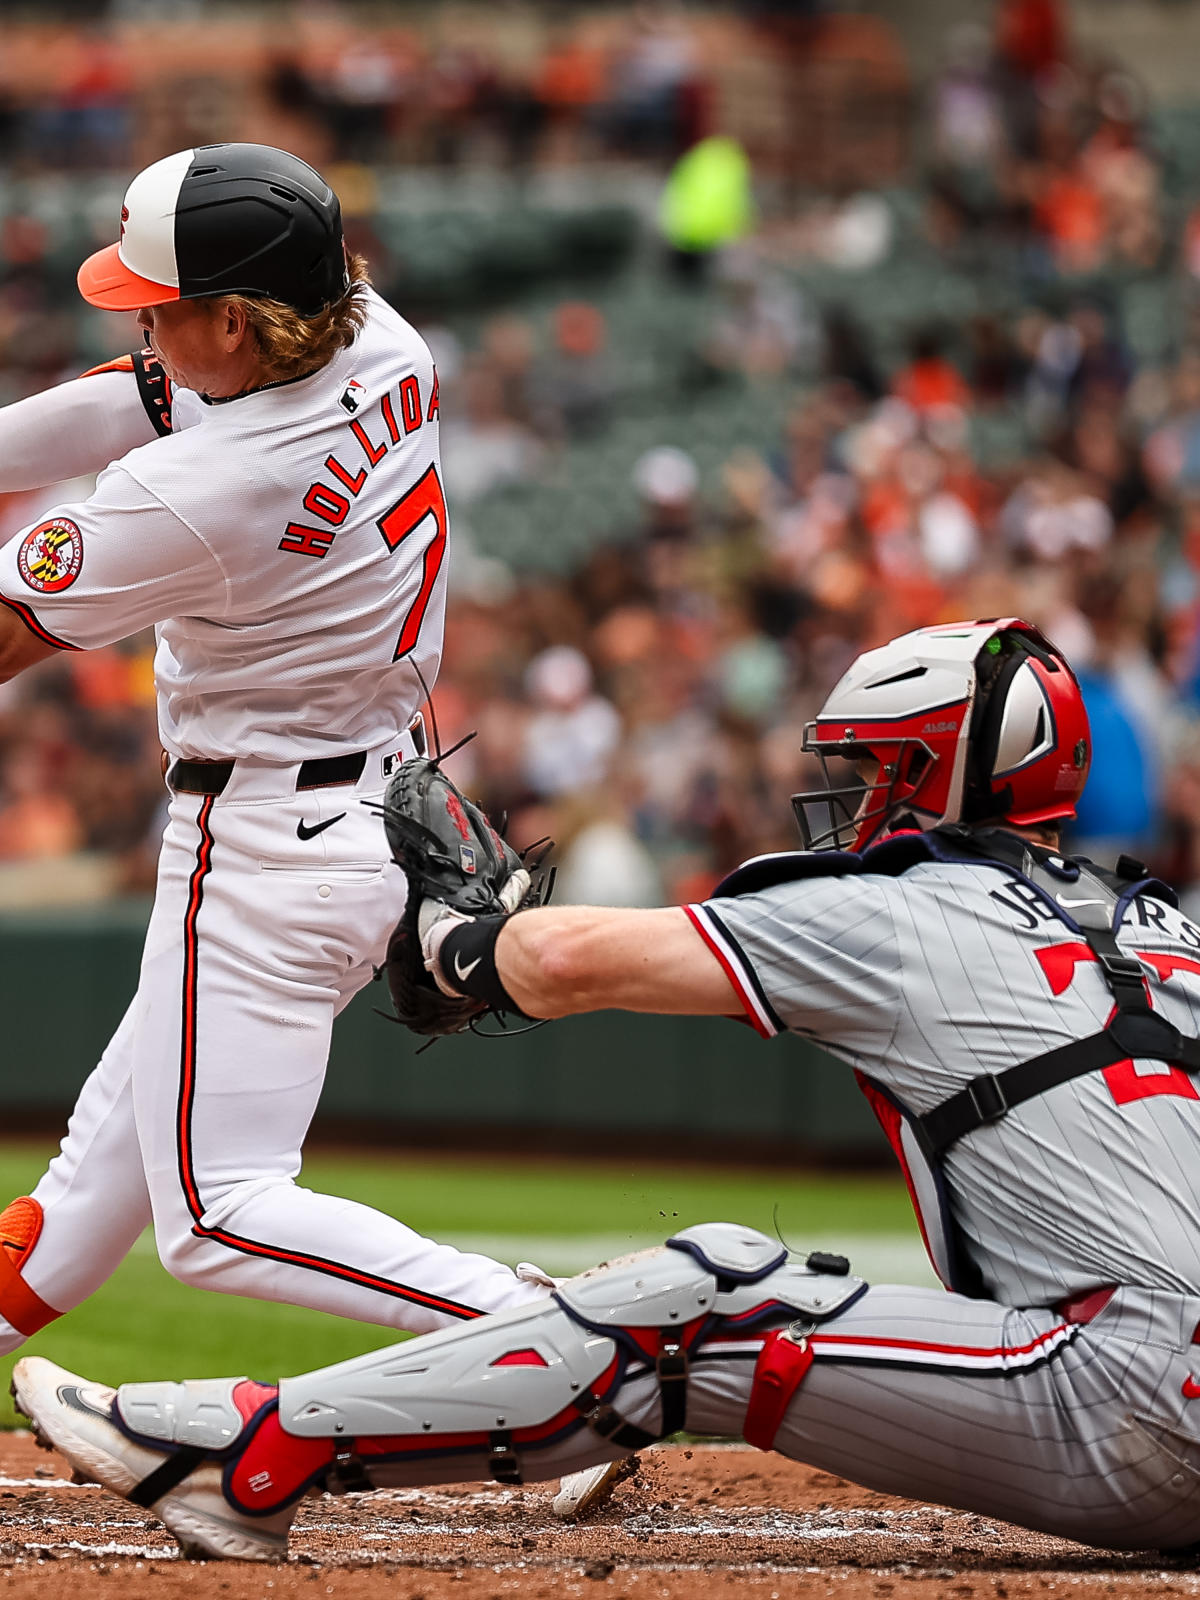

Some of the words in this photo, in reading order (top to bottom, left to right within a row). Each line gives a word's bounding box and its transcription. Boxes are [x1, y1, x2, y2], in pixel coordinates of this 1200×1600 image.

[277, 364, 440, 559] HOLLIDA
[19, 543, 45, 589] ORIOLES
[52, 519, 81, 576] BALTIMORE
[375, 460, 447, 664] 7
